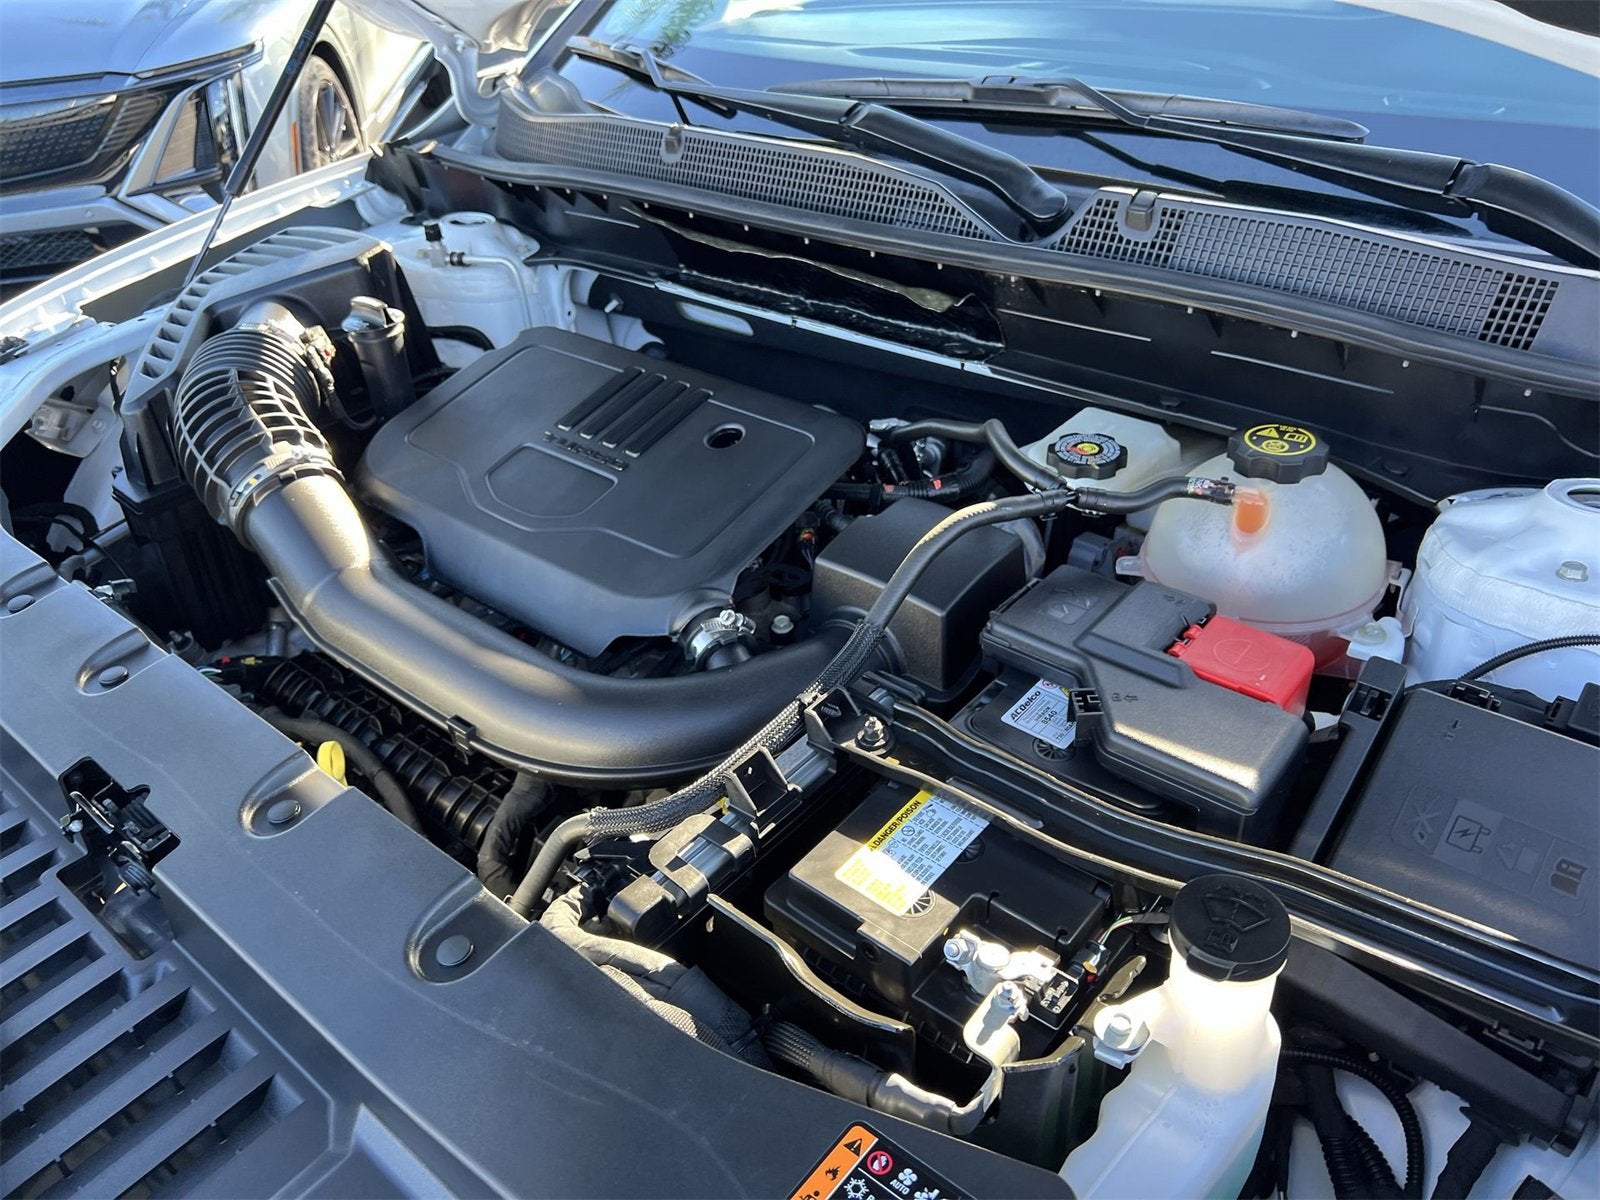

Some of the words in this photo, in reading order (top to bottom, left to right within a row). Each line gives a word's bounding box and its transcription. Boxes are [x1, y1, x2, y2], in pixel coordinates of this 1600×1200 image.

[1010, 690, 1041, 720] ACDelco
[873, 800, 922, 847] DANGER/POISON
[889, 1178, 910, 1195] AUTO
